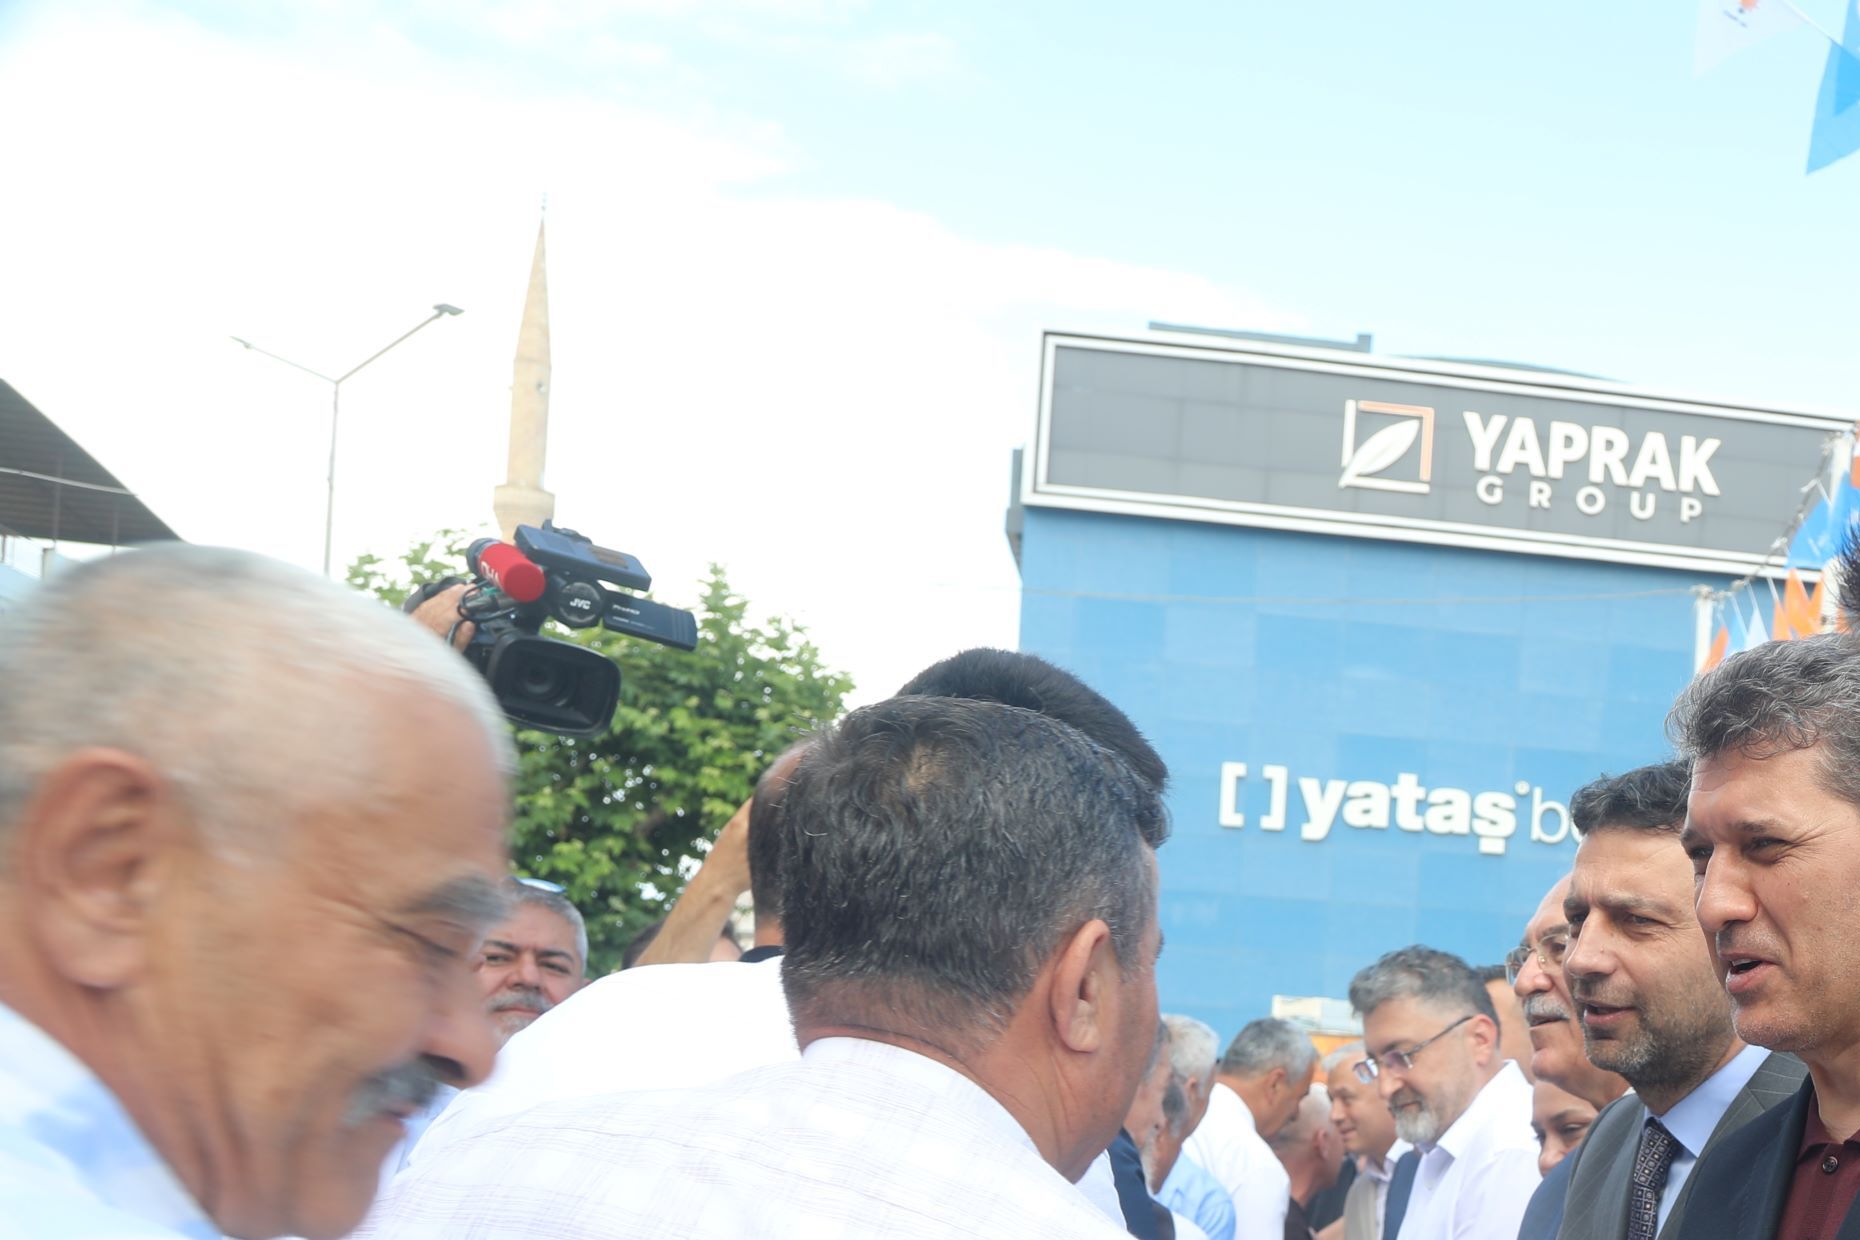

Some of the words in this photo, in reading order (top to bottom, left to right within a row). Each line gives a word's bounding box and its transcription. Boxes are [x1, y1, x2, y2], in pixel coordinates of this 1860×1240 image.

[1462, 411, 1722, 496] YAPRAK
[1476, 475, 1702, 523] GROUP
[569, 598, 592, 610] JVC
[1299, 772, 1517, 855] yataş
